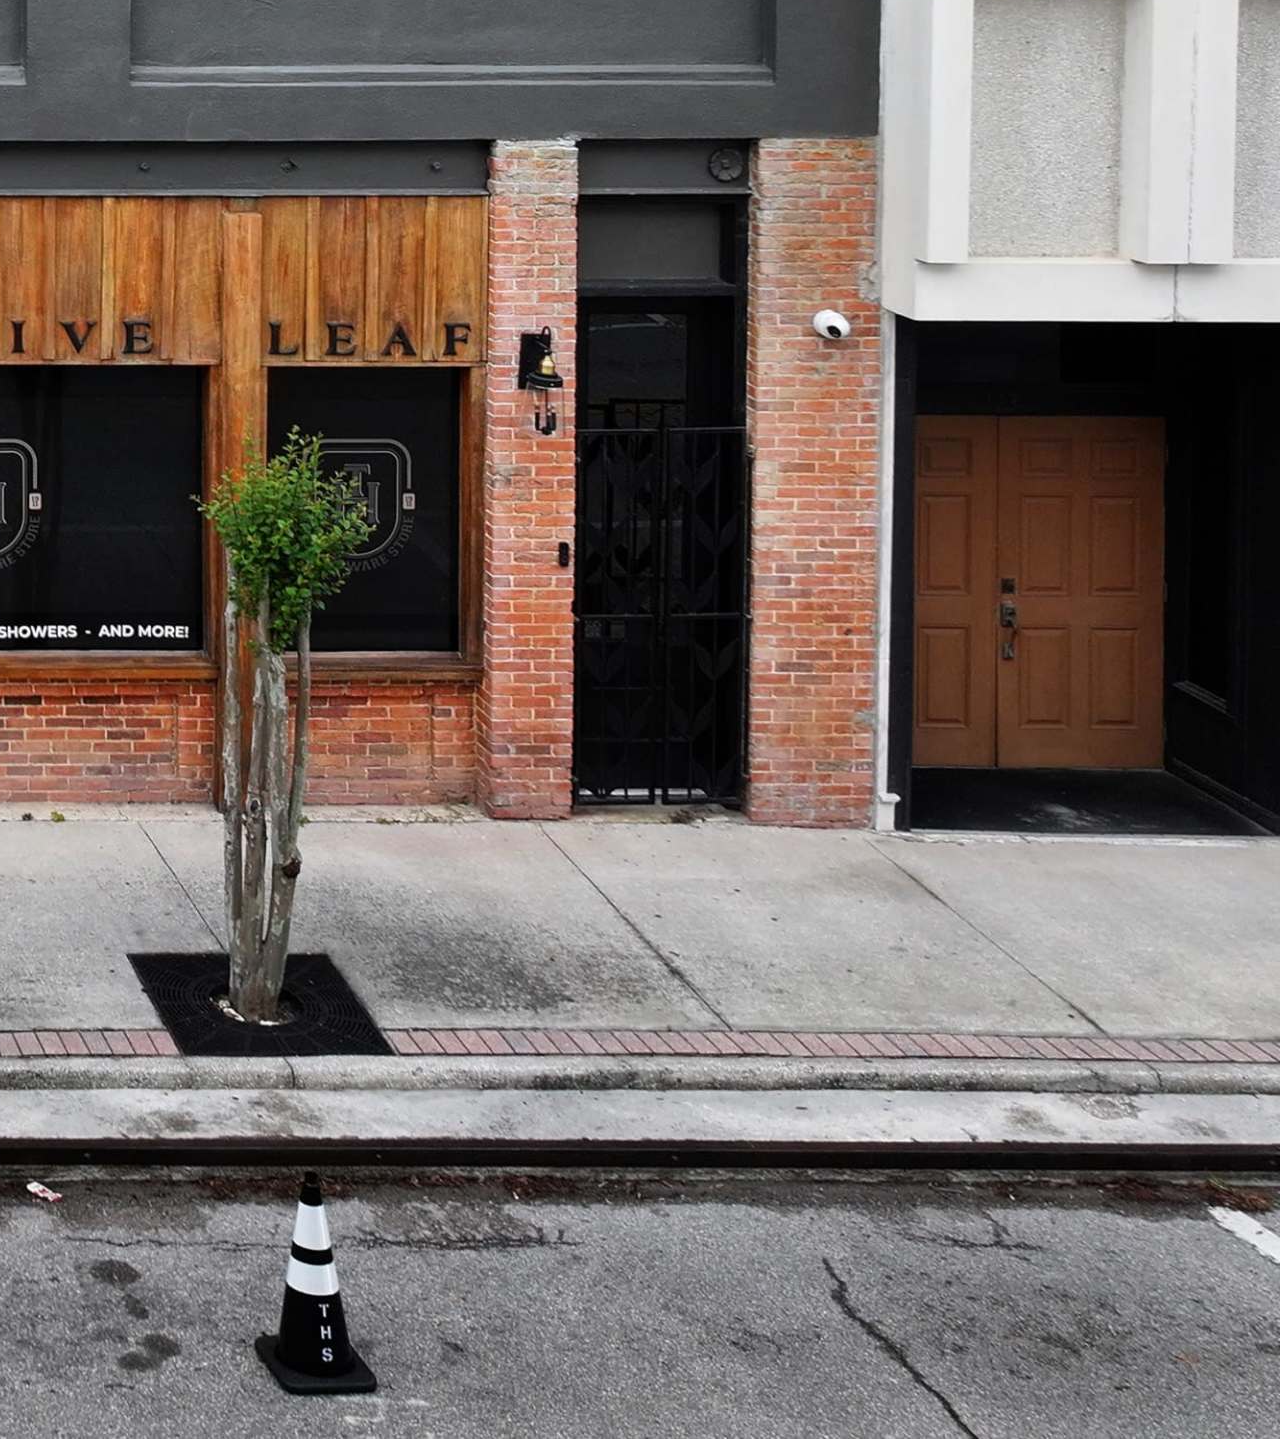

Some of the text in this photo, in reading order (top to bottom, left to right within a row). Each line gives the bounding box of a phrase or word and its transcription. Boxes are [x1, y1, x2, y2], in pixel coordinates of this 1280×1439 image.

[267, 320, 473, 357] LEAF
[15, 515, 42, 557] STORE
[387, 515, 415, 557] STORE
[98, 624, 134, 638] AND
[137, 624, 189, 639] MORE!
